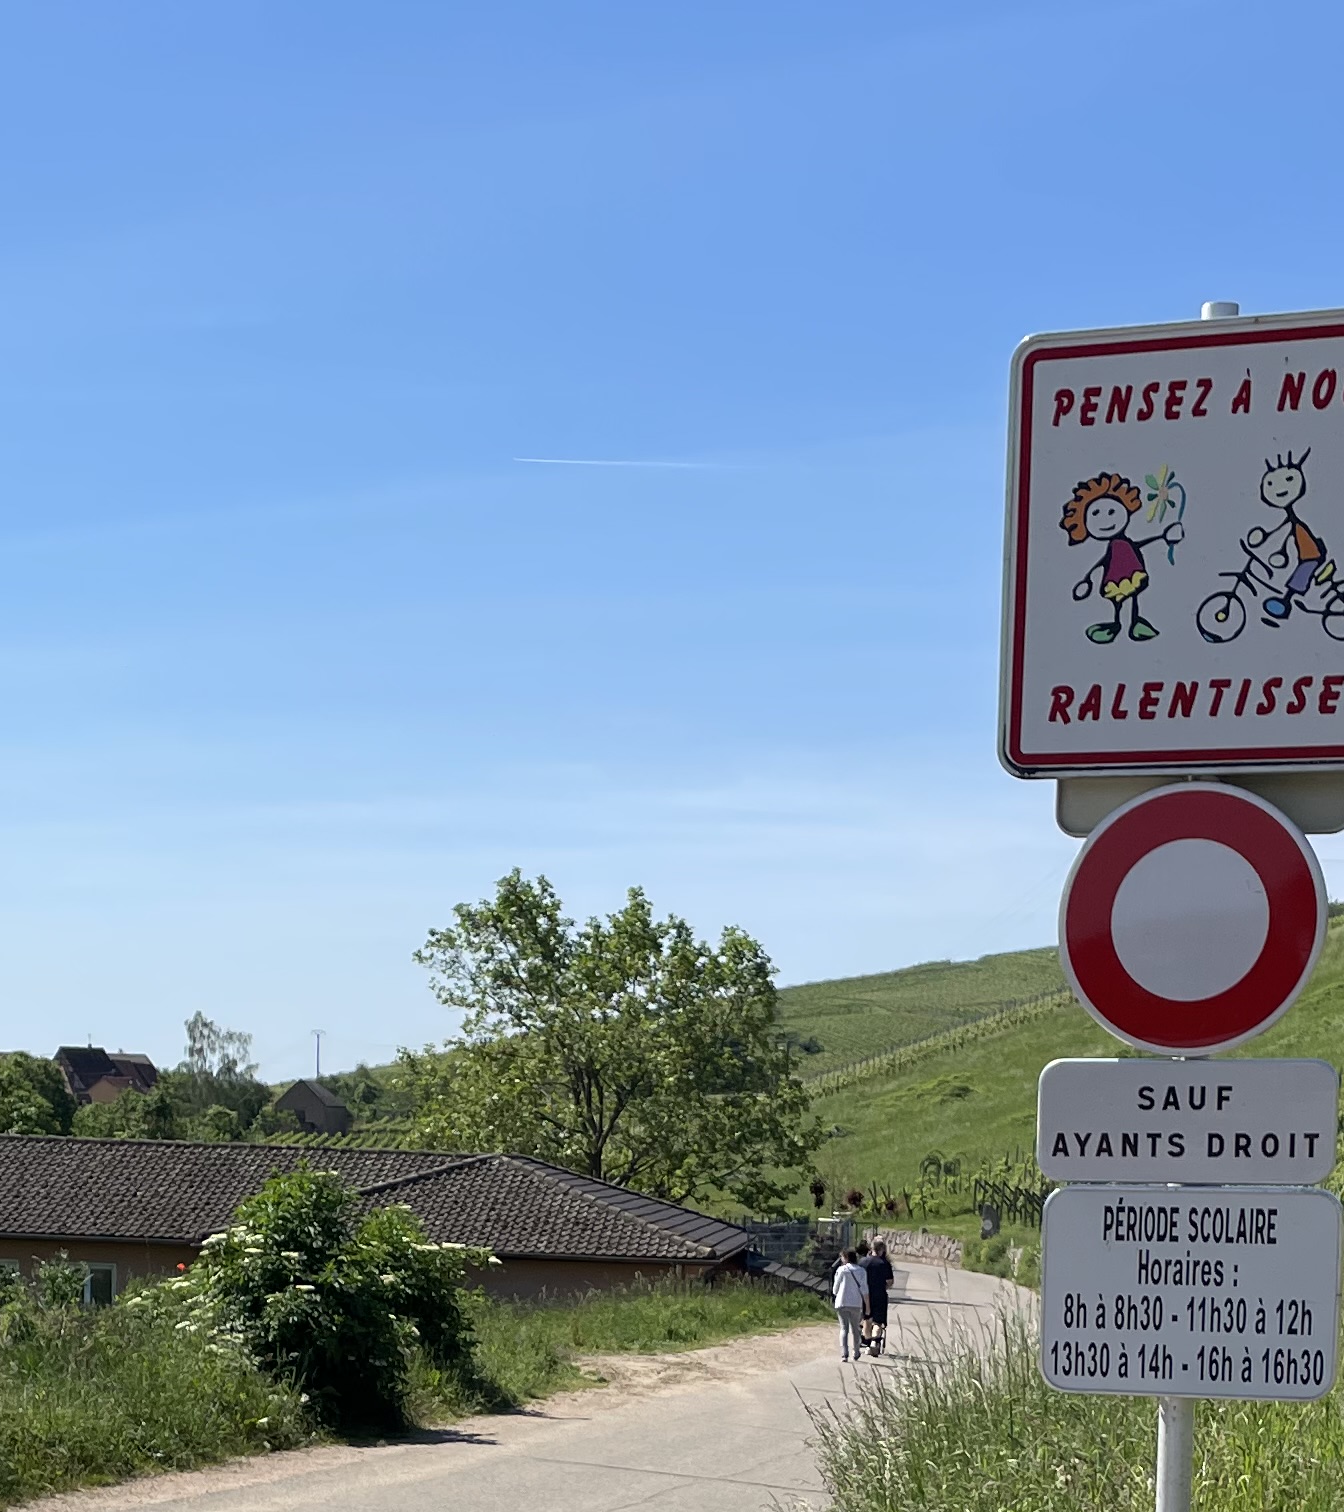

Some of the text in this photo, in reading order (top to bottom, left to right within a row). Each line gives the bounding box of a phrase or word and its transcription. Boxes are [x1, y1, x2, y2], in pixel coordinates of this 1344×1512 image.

[1052, 378, 1213, 427] PENSEZ
[1231, 368, 1253, 414] À
[1137, 1086, 1234, 1111] SAUF
[1051, 1132, 1320, 1158] AYANTS DROIT
[1102, 1198, 1278, 1245] PÉRIODE SCOLAIRE
[1138, 1250, 1224, 1287] Horaires
[1064, 1294, 1087, 1329] 8h
[1095, 1294, 1106, 1329] à
[1114, 1295, 1163, 1331] 8h30
[1187, 1297, 1247, 1333] 11h30
[1255, 1298, 1266, 1334] à
[1276, 1300, 1313, 1336] 12h
[1051, 1341, 1110, 1378] 13h30
[1118, 1343, 1129, 1378] à
[1138, 1344, 1173, 1379] 14h
[1197, 1345, 1233, 1381] 16h
[1241, 1346, 1253, 1382] à
[1262, 1348, 1324, 1386] 16h30
